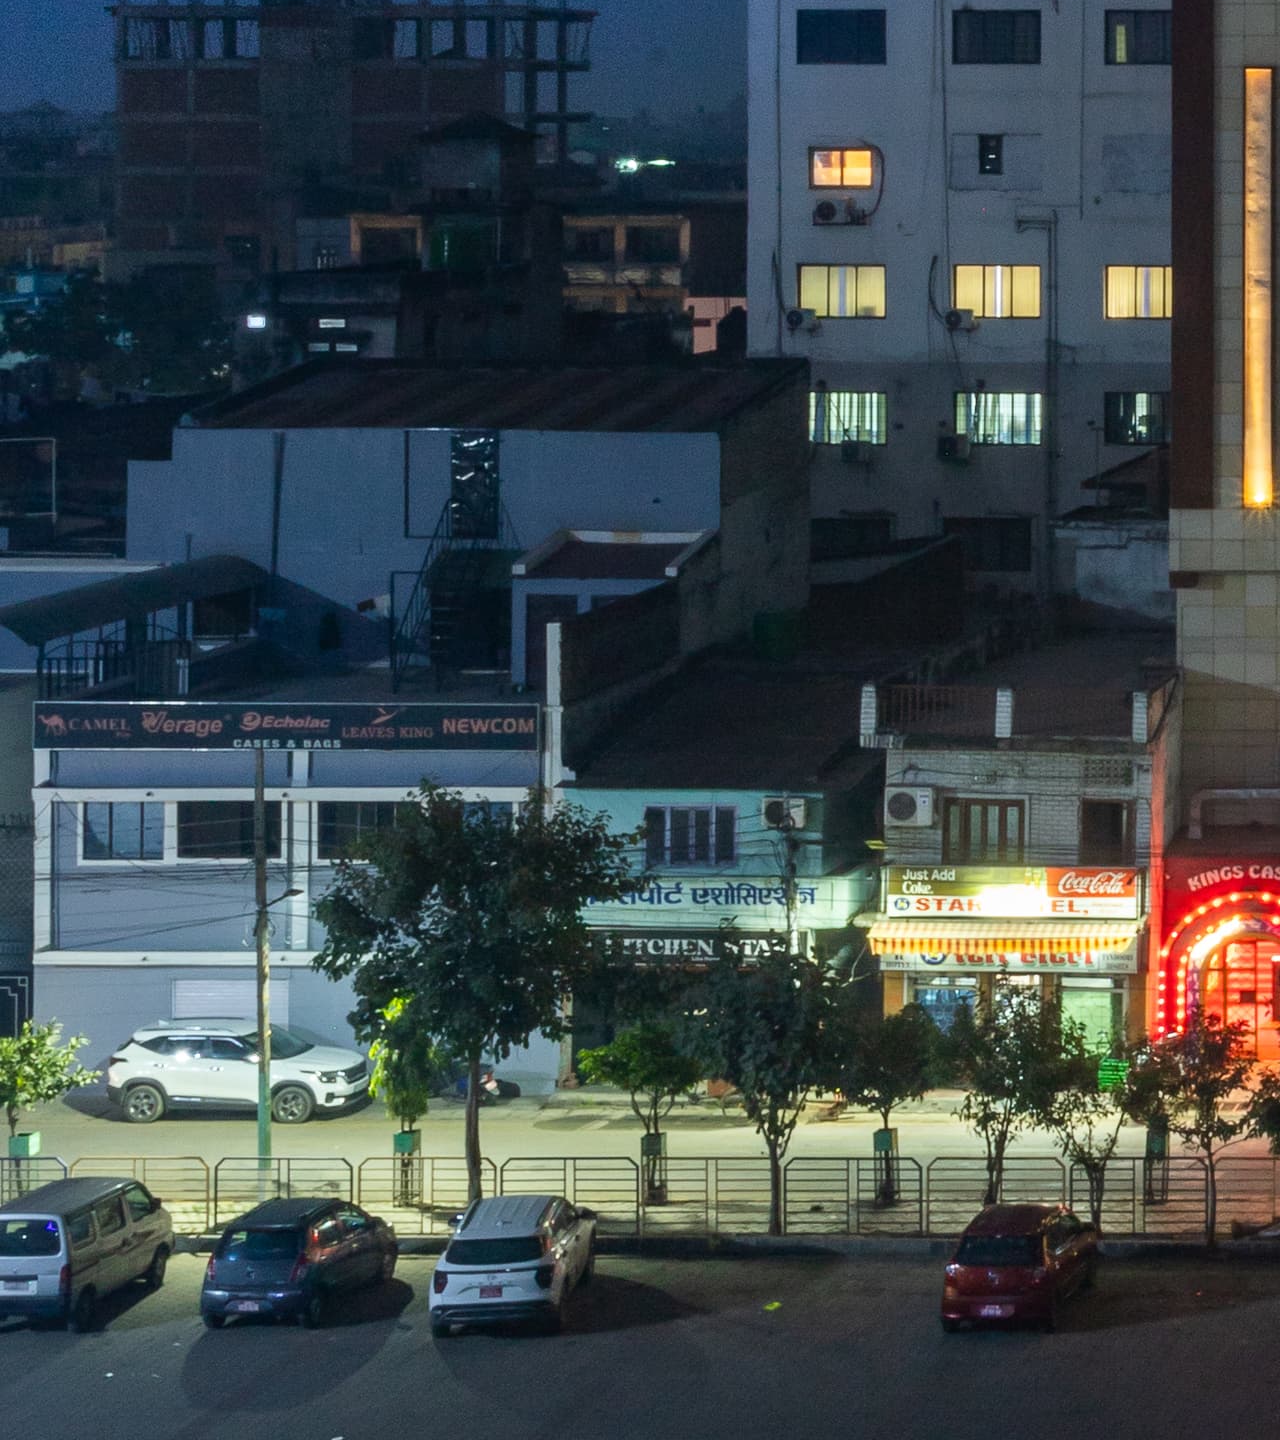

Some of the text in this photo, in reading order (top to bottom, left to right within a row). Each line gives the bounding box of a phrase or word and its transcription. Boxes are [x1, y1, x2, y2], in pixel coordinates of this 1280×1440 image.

[68, 718, 128, 732] CAMEL
[262, 715, 331, 729] Echolac
[341, 727, 396, 739] LEAVES
[400, 727, 435, 739] KING
[233, 739, 342, 749] CASES & BAGS
[902, 869, 956, 881] Just Add
[1187, 865, 1245, 892] KINGS
